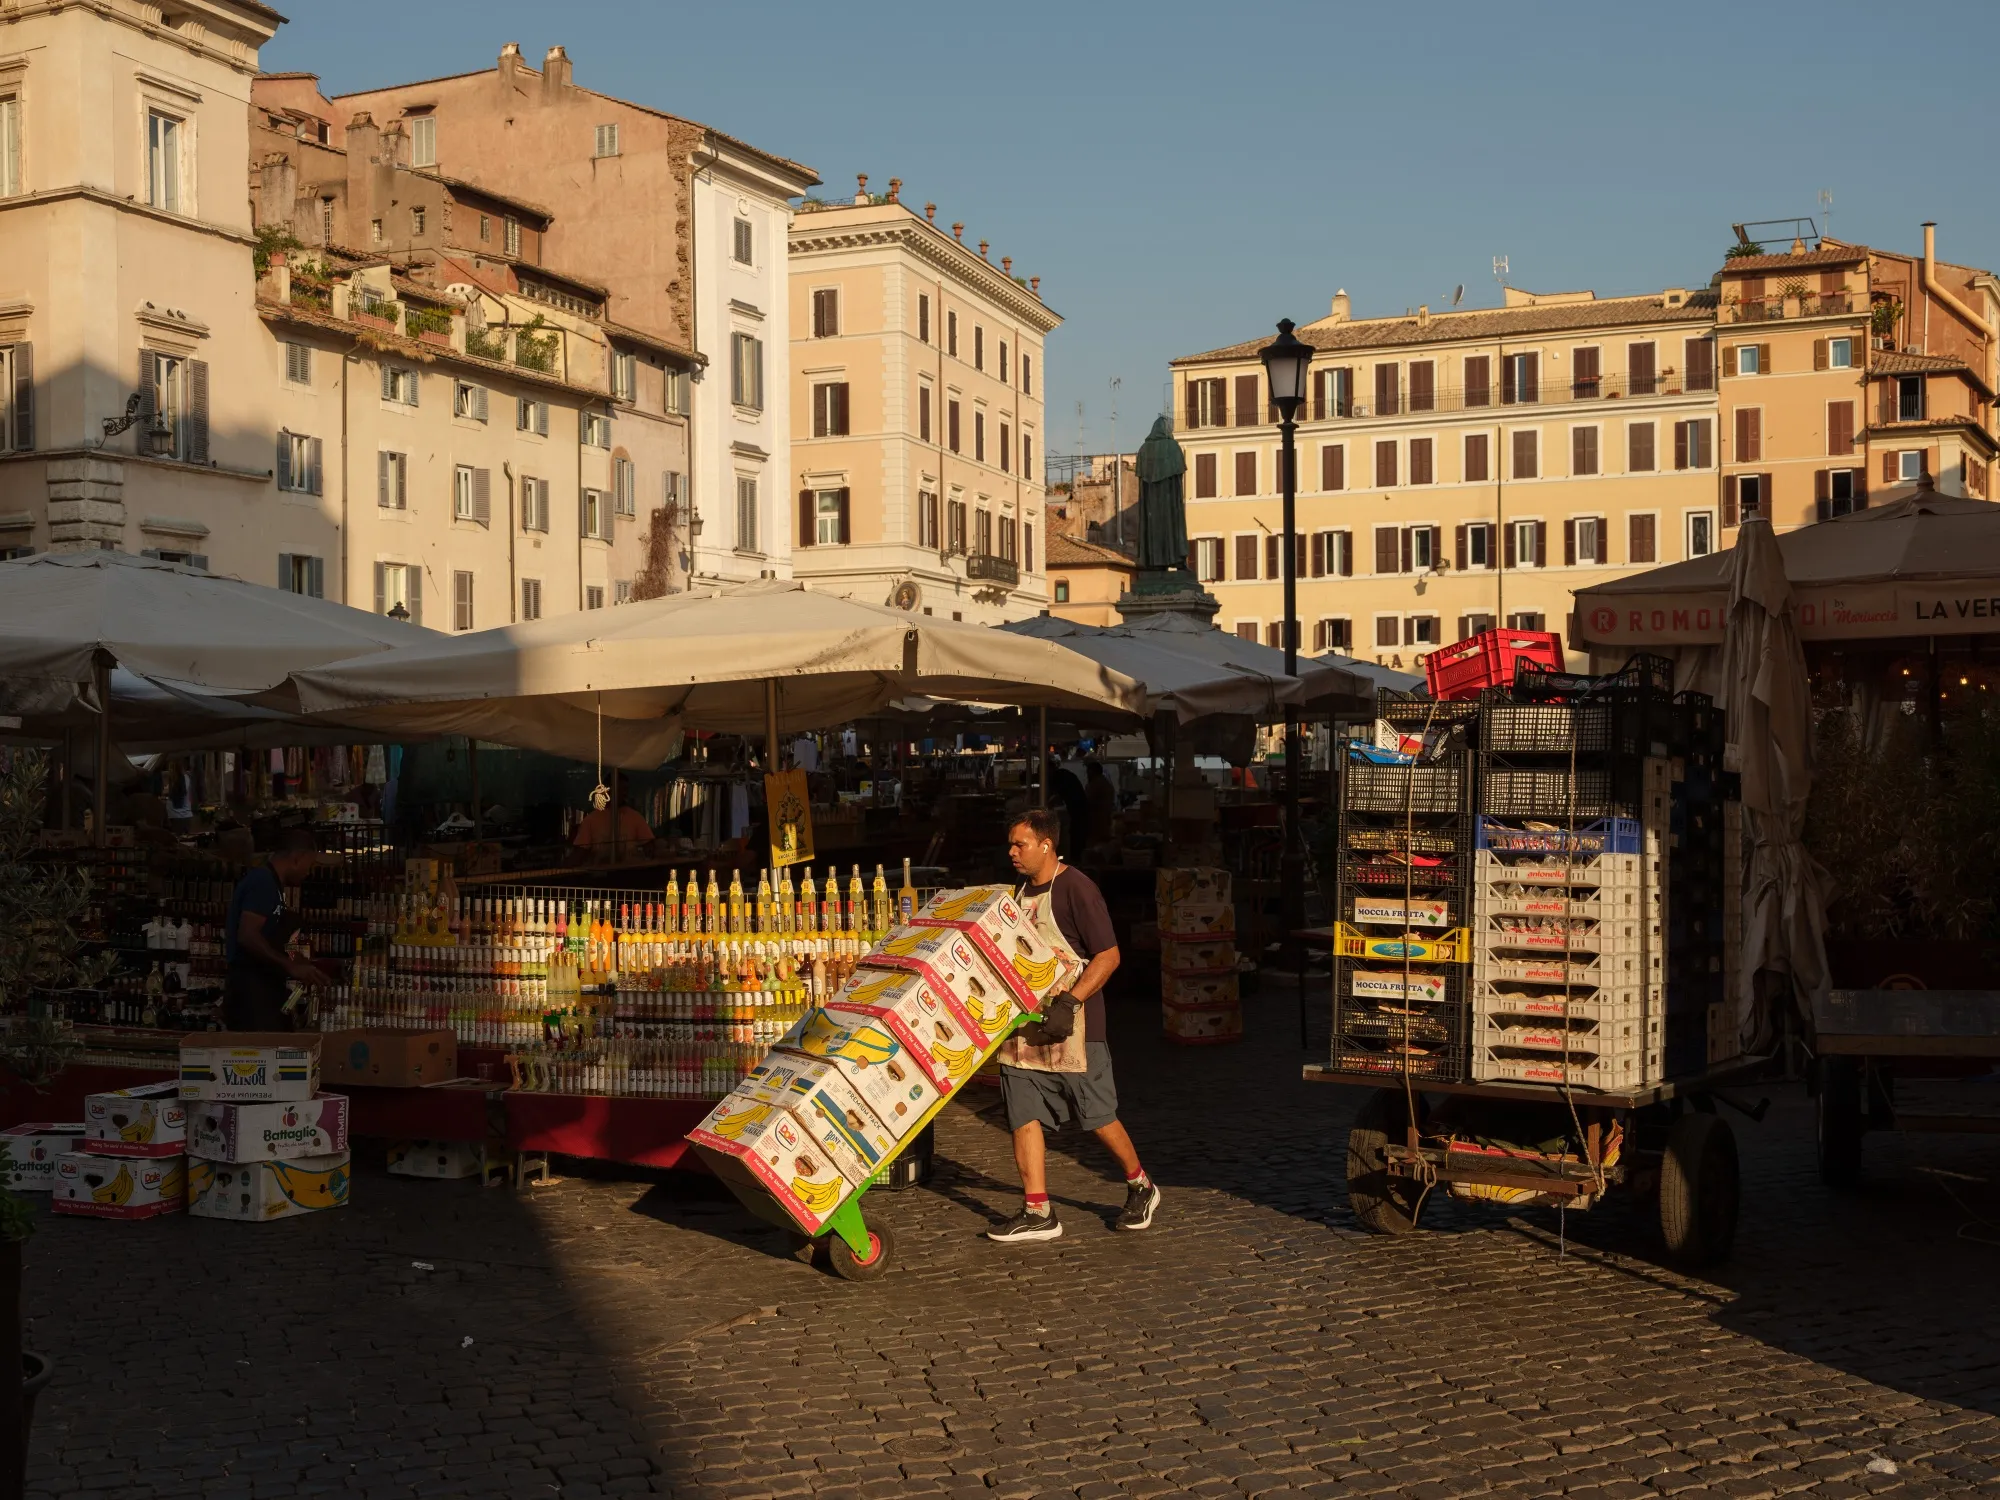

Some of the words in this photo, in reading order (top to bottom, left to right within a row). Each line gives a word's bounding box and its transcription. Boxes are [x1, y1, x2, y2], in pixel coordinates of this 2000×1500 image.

[1834, 599, 1845, 609] by
[1917, 600, 1948, 620] LA
[1528, 870, 1564, 878] antonella
[1526, 902, 1562, 911] antonella
[1003, 903, 1017, 921] Dole
[1527, 936, 1564, 944] antonella
[956, 945, 971, 965] Dole
[1526, 969, 1562, 977] antonella
[921, 990, 937, 1010] Dole
[1525, 1003, 1563, 1011] antonella
[1524, 1035, 1560, 1044] antonella
[222, 1067, 266, 1085] BONITA
[1525, 1068, 1563, 1077] antonella
[847, 1089, 869, 1115] PREMIUM
[867, 1115, 881, 1130] PACK
[168, 1111, 184, 1120] Dole
[263, 1126, 317, 1141] Battaglio
[780, 1125, 797, 1144] Dole
[11, 1160, 54, 1173] Battagl
[145, 1173, 160, 1181] Dole
